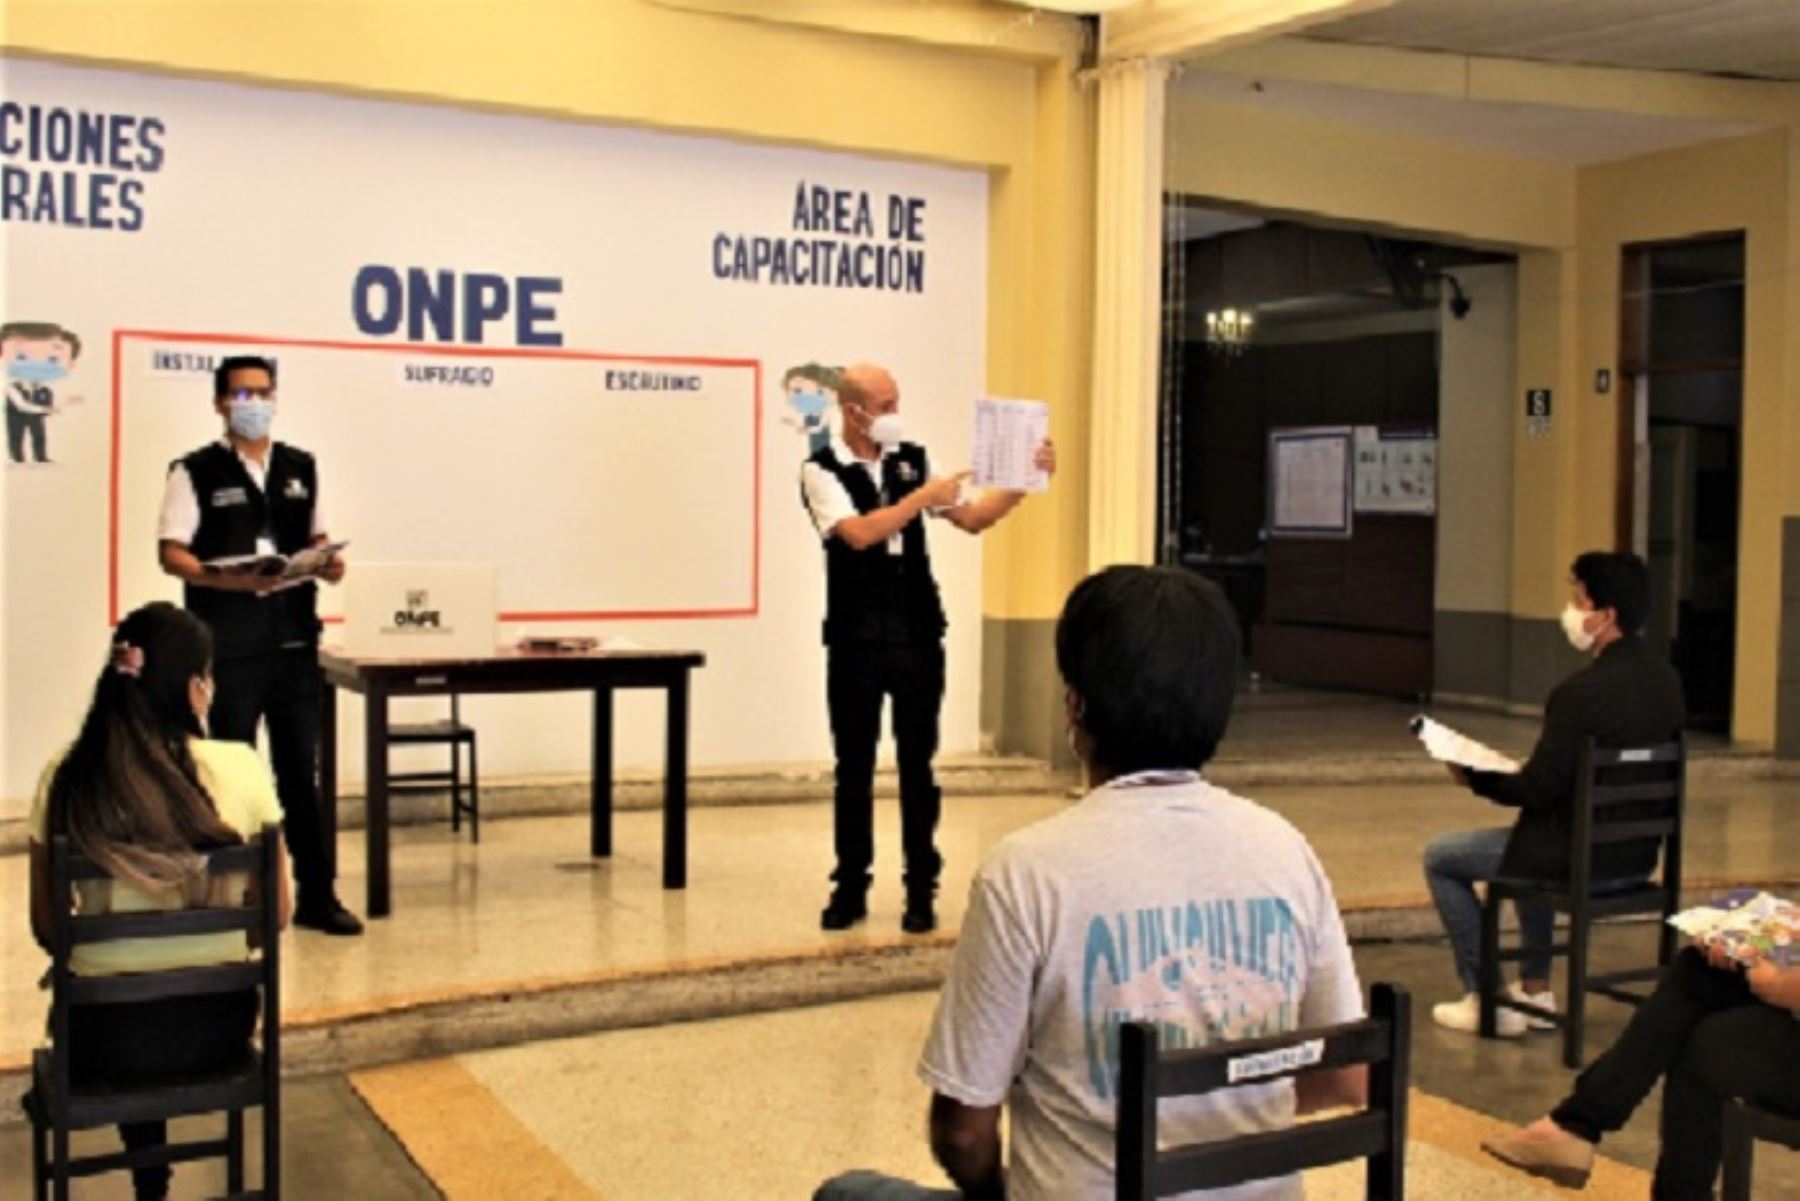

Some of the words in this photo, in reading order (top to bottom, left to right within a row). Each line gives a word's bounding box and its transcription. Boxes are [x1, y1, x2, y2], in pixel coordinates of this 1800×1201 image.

[0, 102, 165, 172] CIONES
[1, 164, 144, 231] RALES
[888, 194, 925, 241] DE
[713, 232, 924, 293] CAPACITACIÓN
[352, 264, 563, 346] ONPE
